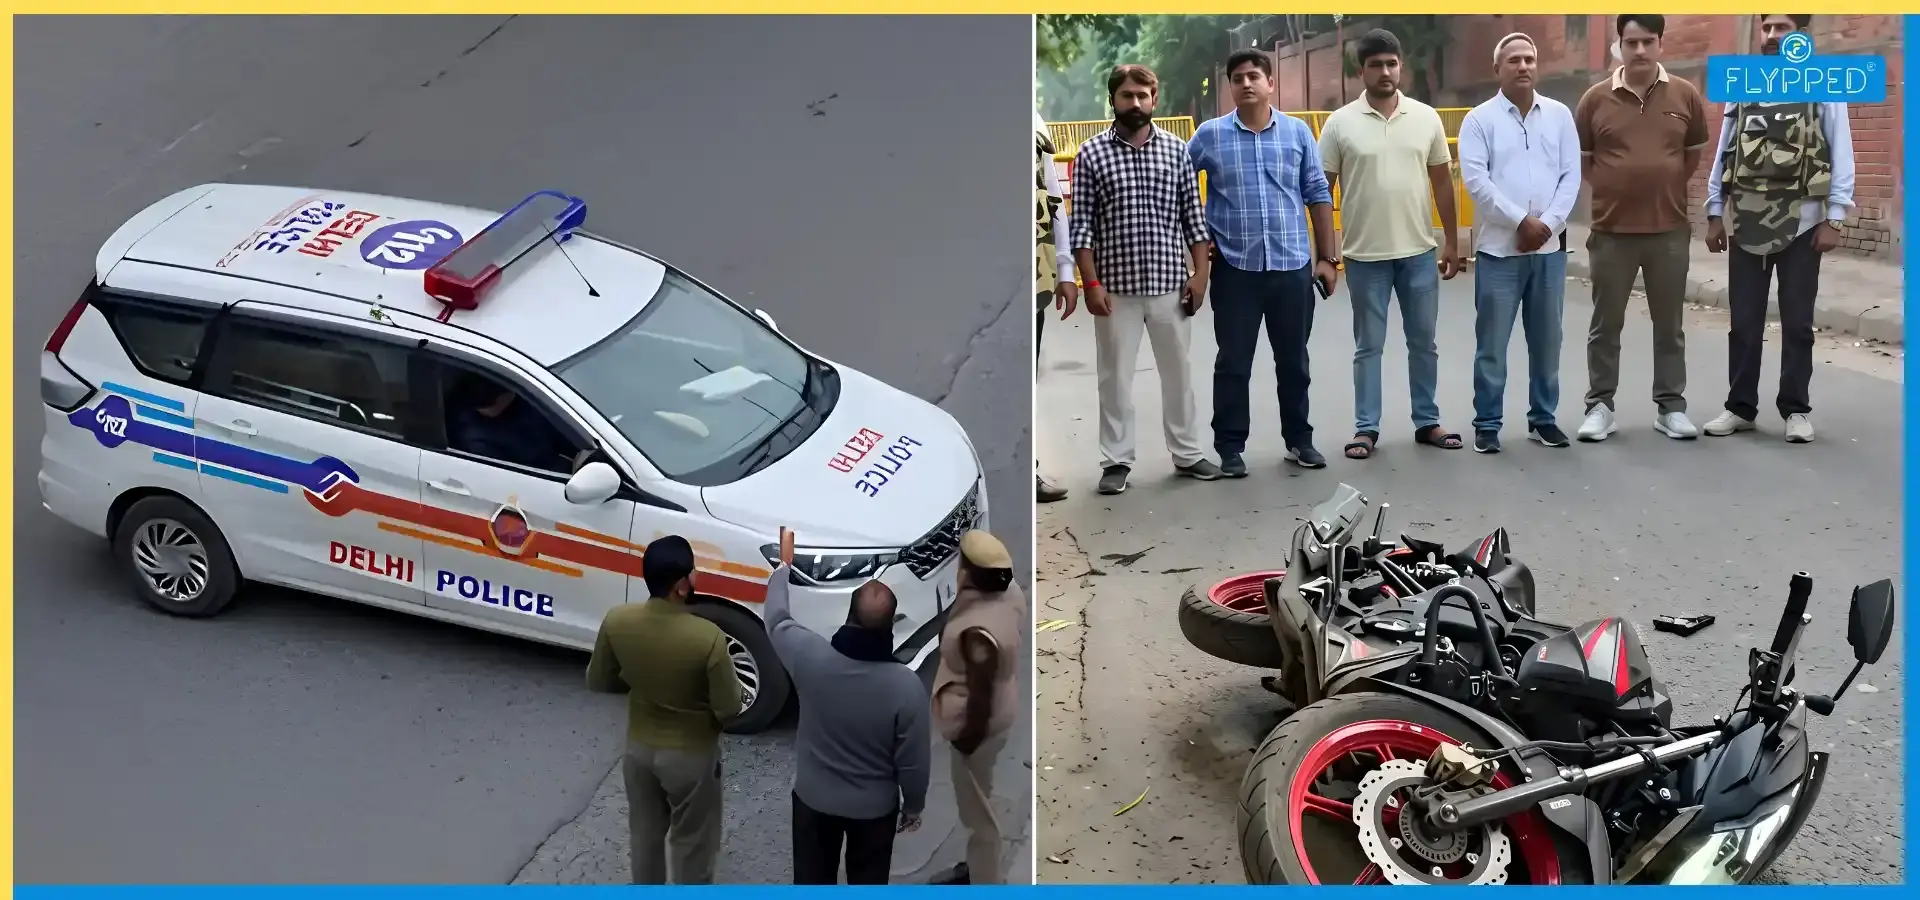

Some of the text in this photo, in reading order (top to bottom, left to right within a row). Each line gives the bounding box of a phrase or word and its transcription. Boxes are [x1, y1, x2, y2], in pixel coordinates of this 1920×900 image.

[297, 210, 380, 257] DELHI
[366, 230, 436, 263] 112
[329, 540, 554, 617] DELHI POLICE
